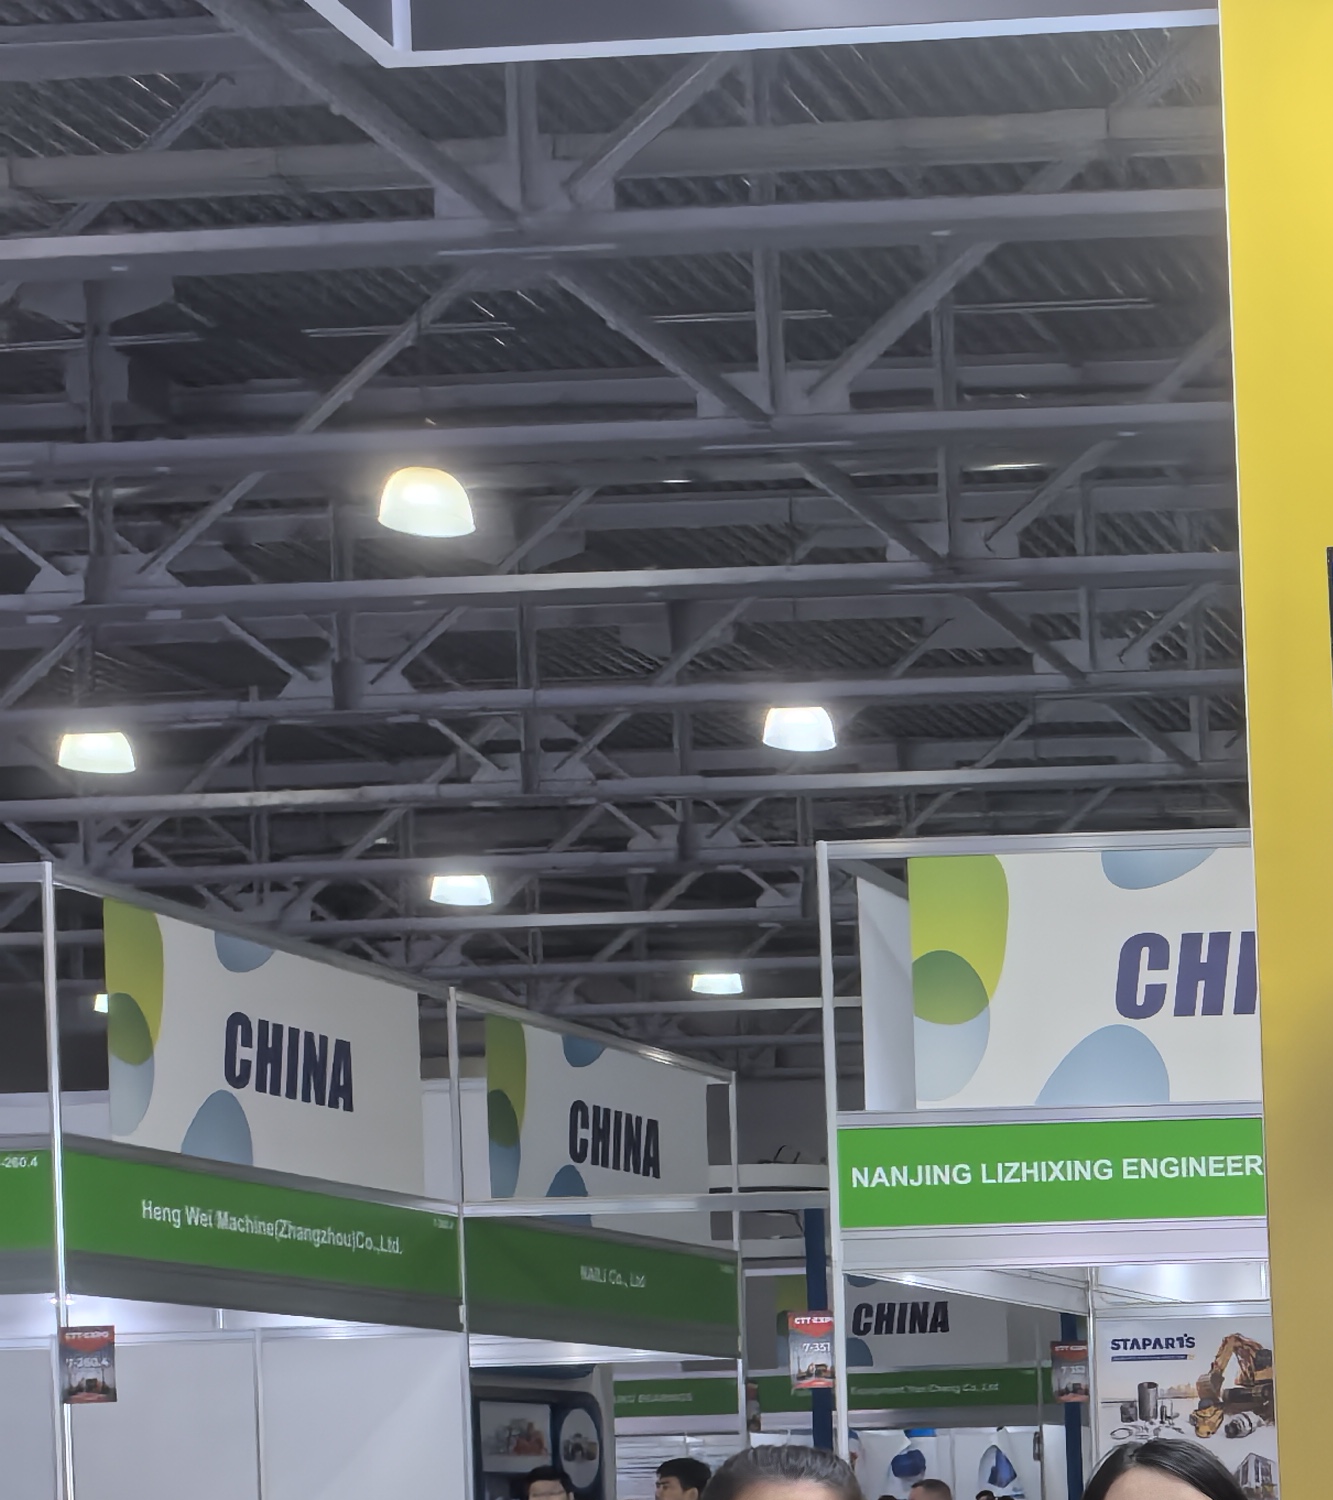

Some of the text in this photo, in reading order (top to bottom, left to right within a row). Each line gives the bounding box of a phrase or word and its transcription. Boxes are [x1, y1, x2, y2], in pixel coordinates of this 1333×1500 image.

[1115, 931, 1258, 1020] CHI
[224, 1012, 354, 1112] CHINA
[569, 1100, 660, 1179] CHINA
[851, 1155, 1263, 1188] NANJING LIZHIXING ENGINEER
[141, 1199, 181, 1228] Heng
[185, 1205, 213, 1228] Wei
[852, 1301, 950, 1336] CHINA
